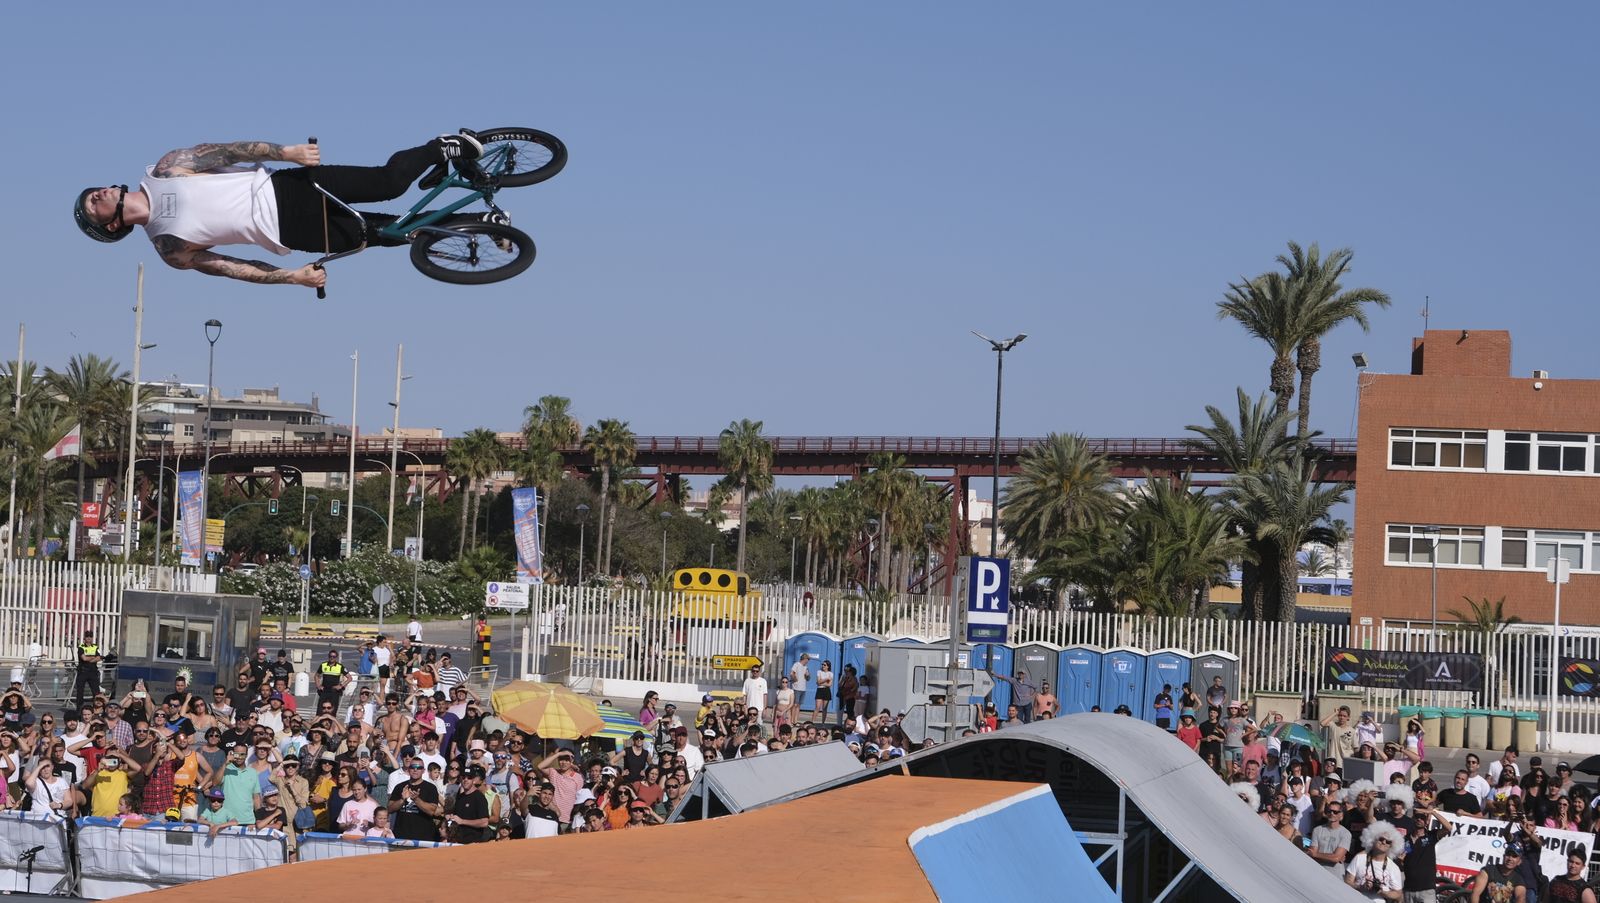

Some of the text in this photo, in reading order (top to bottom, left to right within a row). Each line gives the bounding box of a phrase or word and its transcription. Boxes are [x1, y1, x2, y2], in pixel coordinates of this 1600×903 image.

[491, 133, 532, 142] ODYSSEY
[976, 561, 1001, 609] P
[1468, 851, 1485, 864] EN
